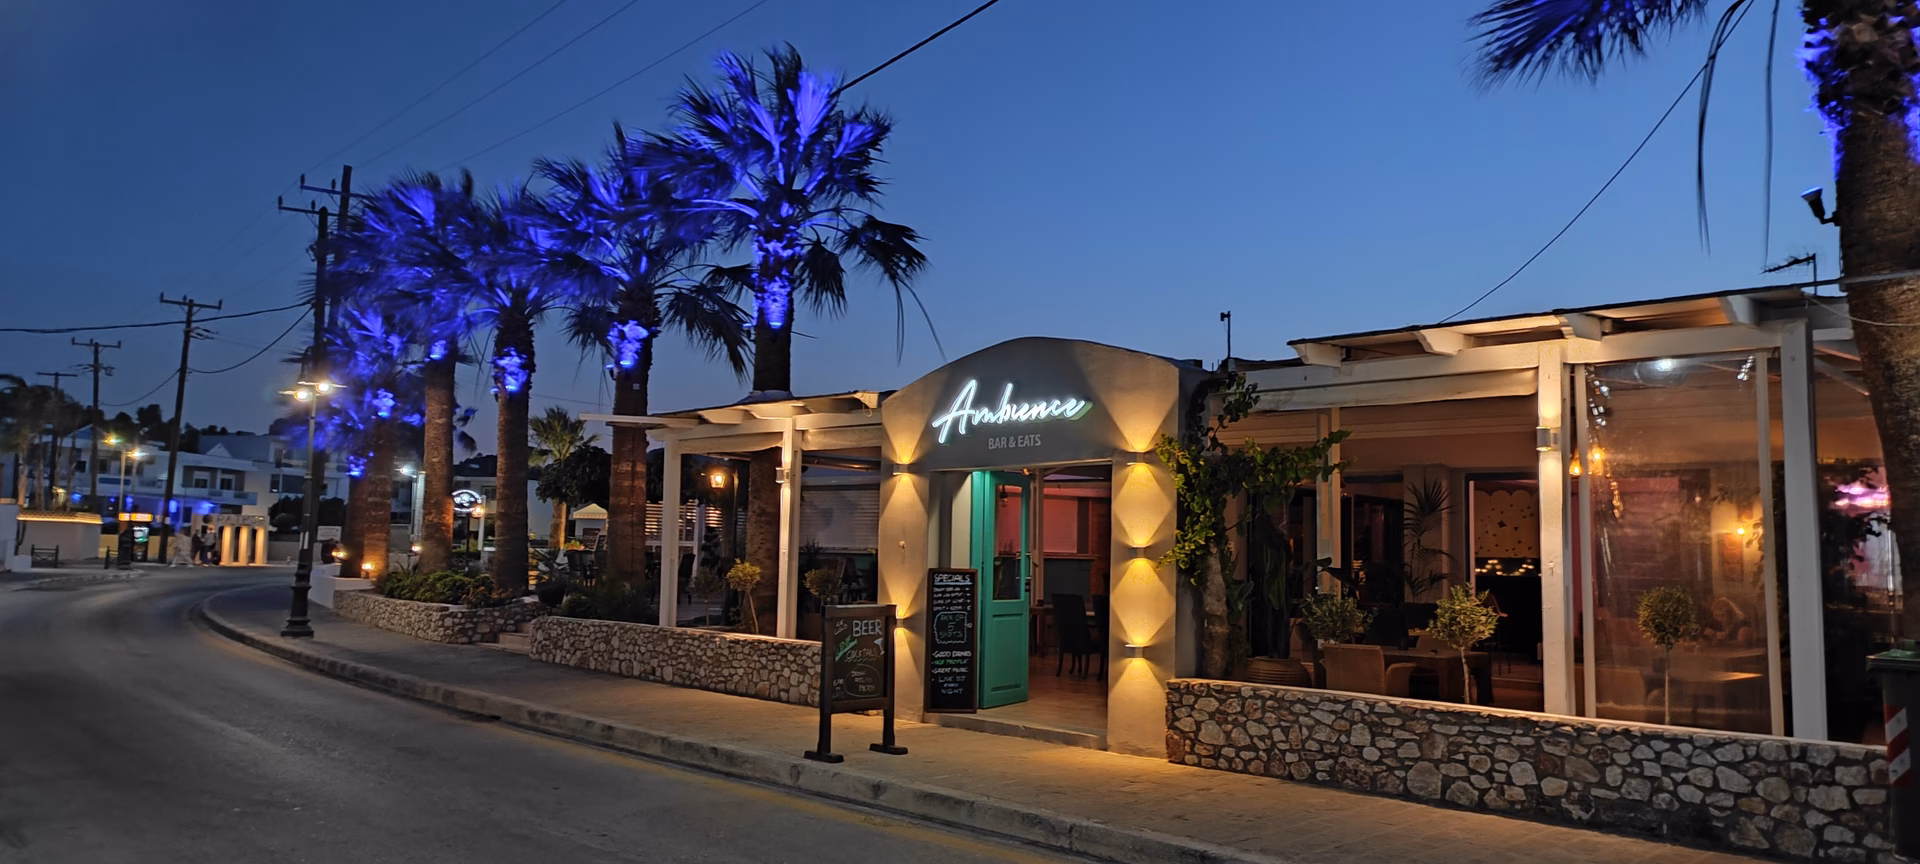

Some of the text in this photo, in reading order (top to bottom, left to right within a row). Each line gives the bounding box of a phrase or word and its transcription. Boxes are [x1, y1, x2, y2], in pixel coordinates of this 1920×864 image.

[931, 379, 1086, 444] Ambience
[988, 434, 1041, 450] BAR & EATS
[934, 574, 971, 582] SPECIALS
[852, 619, 883, 637] BEER
[947, 622, 956, 631] 5
